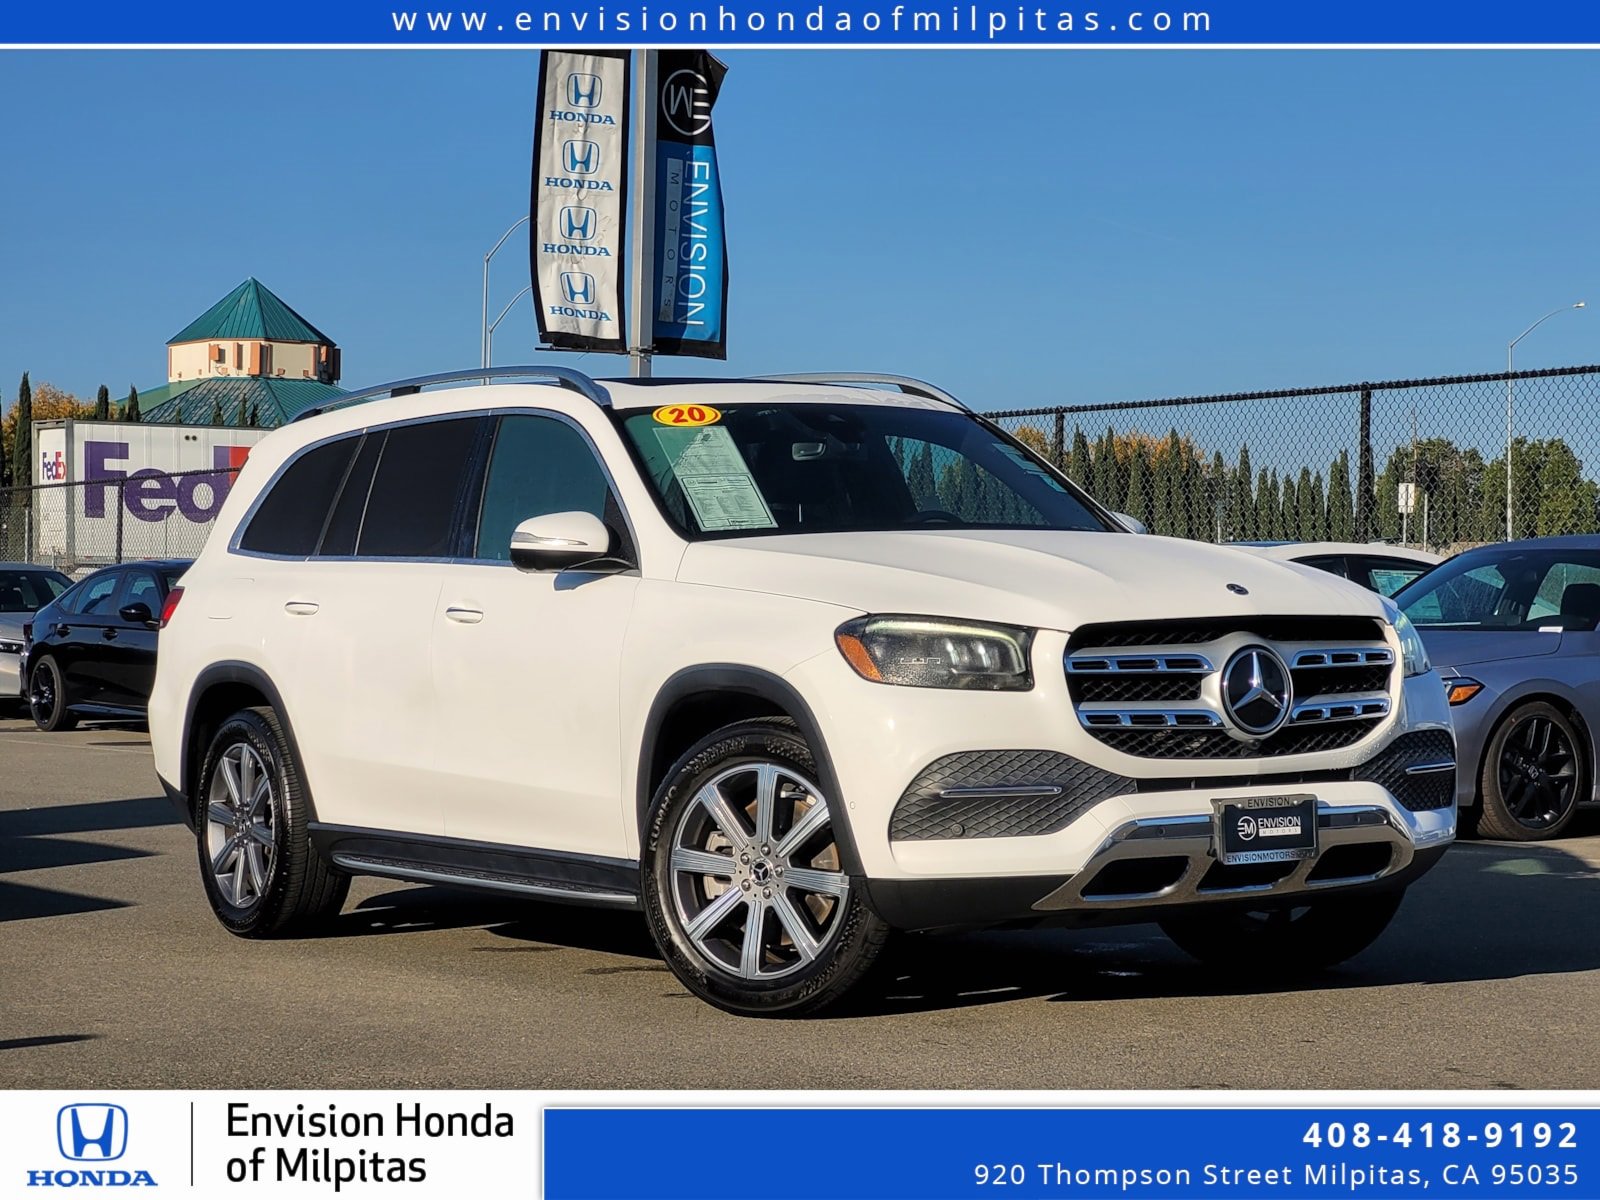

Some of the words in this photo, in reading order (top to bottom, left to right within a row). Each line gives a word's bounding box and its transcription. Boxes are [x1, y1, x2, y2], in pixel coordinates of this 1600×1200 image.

[549, 110, 616, 126] HONDA
[544, 176, 614, 192] HONDA
[663, 171, 680, 308] MOTORS
[676, 160, 710, 326] ENVISION
[543, 242, 612, 258] HONDA
[549, 305, 613, 322] HONDA
[668, 406, 706, 424] 20
[84, 440, 252, 524] Fed
[1247, 797, 1290, 808] ENVISION
[648, 785, 678, 852] KUMHO
[1257, 815, 1301, 828] ENVISION
[1261, 828, 1299, 836] MOTORS
[1226, 850, 1314, 863] ENVISIONMOTORS
